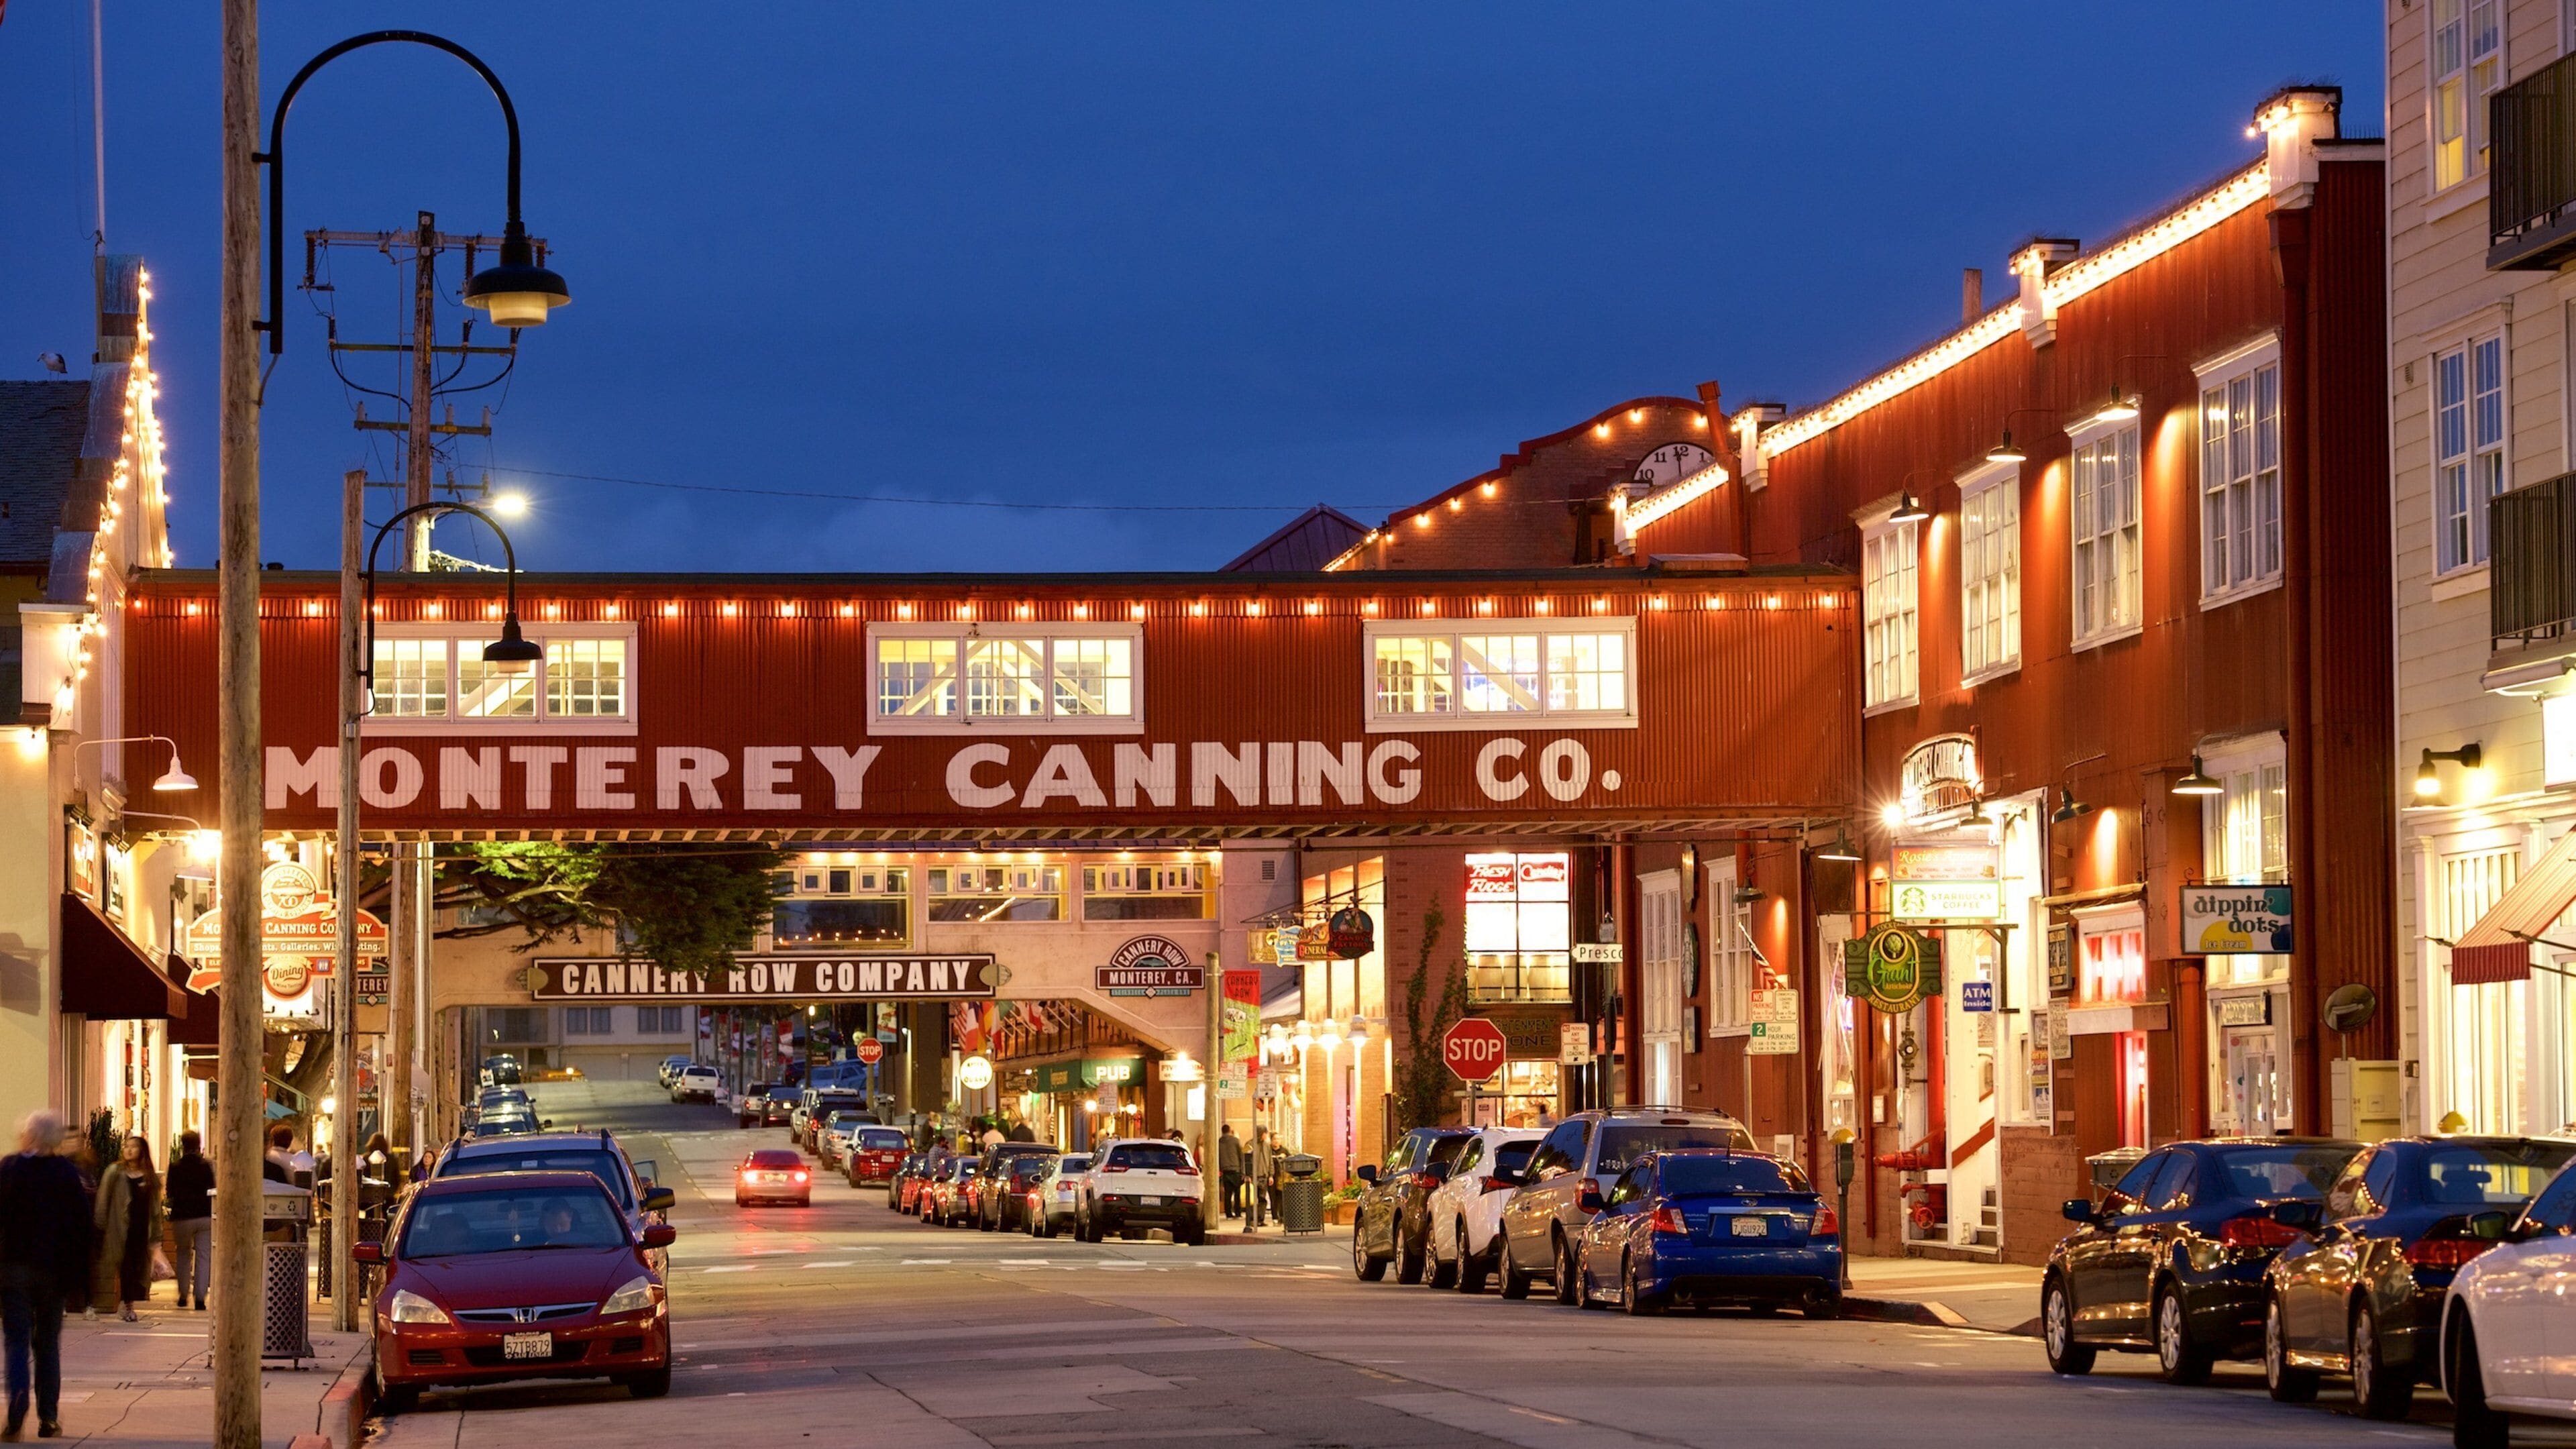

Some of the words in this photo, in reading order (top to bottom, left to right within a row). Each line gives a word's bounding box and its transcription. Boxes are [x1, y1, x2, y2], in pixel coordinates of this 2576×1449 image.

[1672, 445, 1689, 457] 12
[1654, 452, 1667, 463] 11
[1638, 468, 1654, 480] 10
[265, 745, 883, 810] MONTEREY
[945, 739, 1421, 808] CANNING
[1476, 737, 1621, 802] CO.
[1468, 864, 1512, 878] FRESH
[1467, 879, 1514, 892] FUDGE
[1931, 893, 1992, 901] STARBUCKS
[265, 922, 317, 934] CANNING
[320, 922, 372, 934] CONY
[2229, 916, 2281, 933] dots
[280, 943, 321, 952] Galleries.
[1118, 940, 1164, 966] CANNERY
[1162, 942, 1185, 966] ROW
[1299, 945, 1328, 957] GENERAL
[271, 966, 304, 982] Dining
[562, 963, 708, 994] CANNERY
[729, 963, 798, 993] ROW
[815, 961, 970, 993] COMPANY
[1109, 971, 1171, 985] MONTEREY,
[1175, 972, 1193, 984] CA.
[1867, 956, 1920, 991] Giant
[1226, 976, 1259, 987] CANNERY
[1234, 987, 1251, 998] ROW
[1753, 992, 1763, 1002] NO
[1964, 987, 1991, 998] ATM
[1868, 994, 1921, 1013] RESTAURANT
[1964, 1000, 1992, 1008] Inside
[1756, 1024, 1764, 1036] 2
[859, 1046, 881, 1056] STOP
[1448, 1038, 1502, 1062] STOP
[1096, 1066, 1130, 1081] PUB
